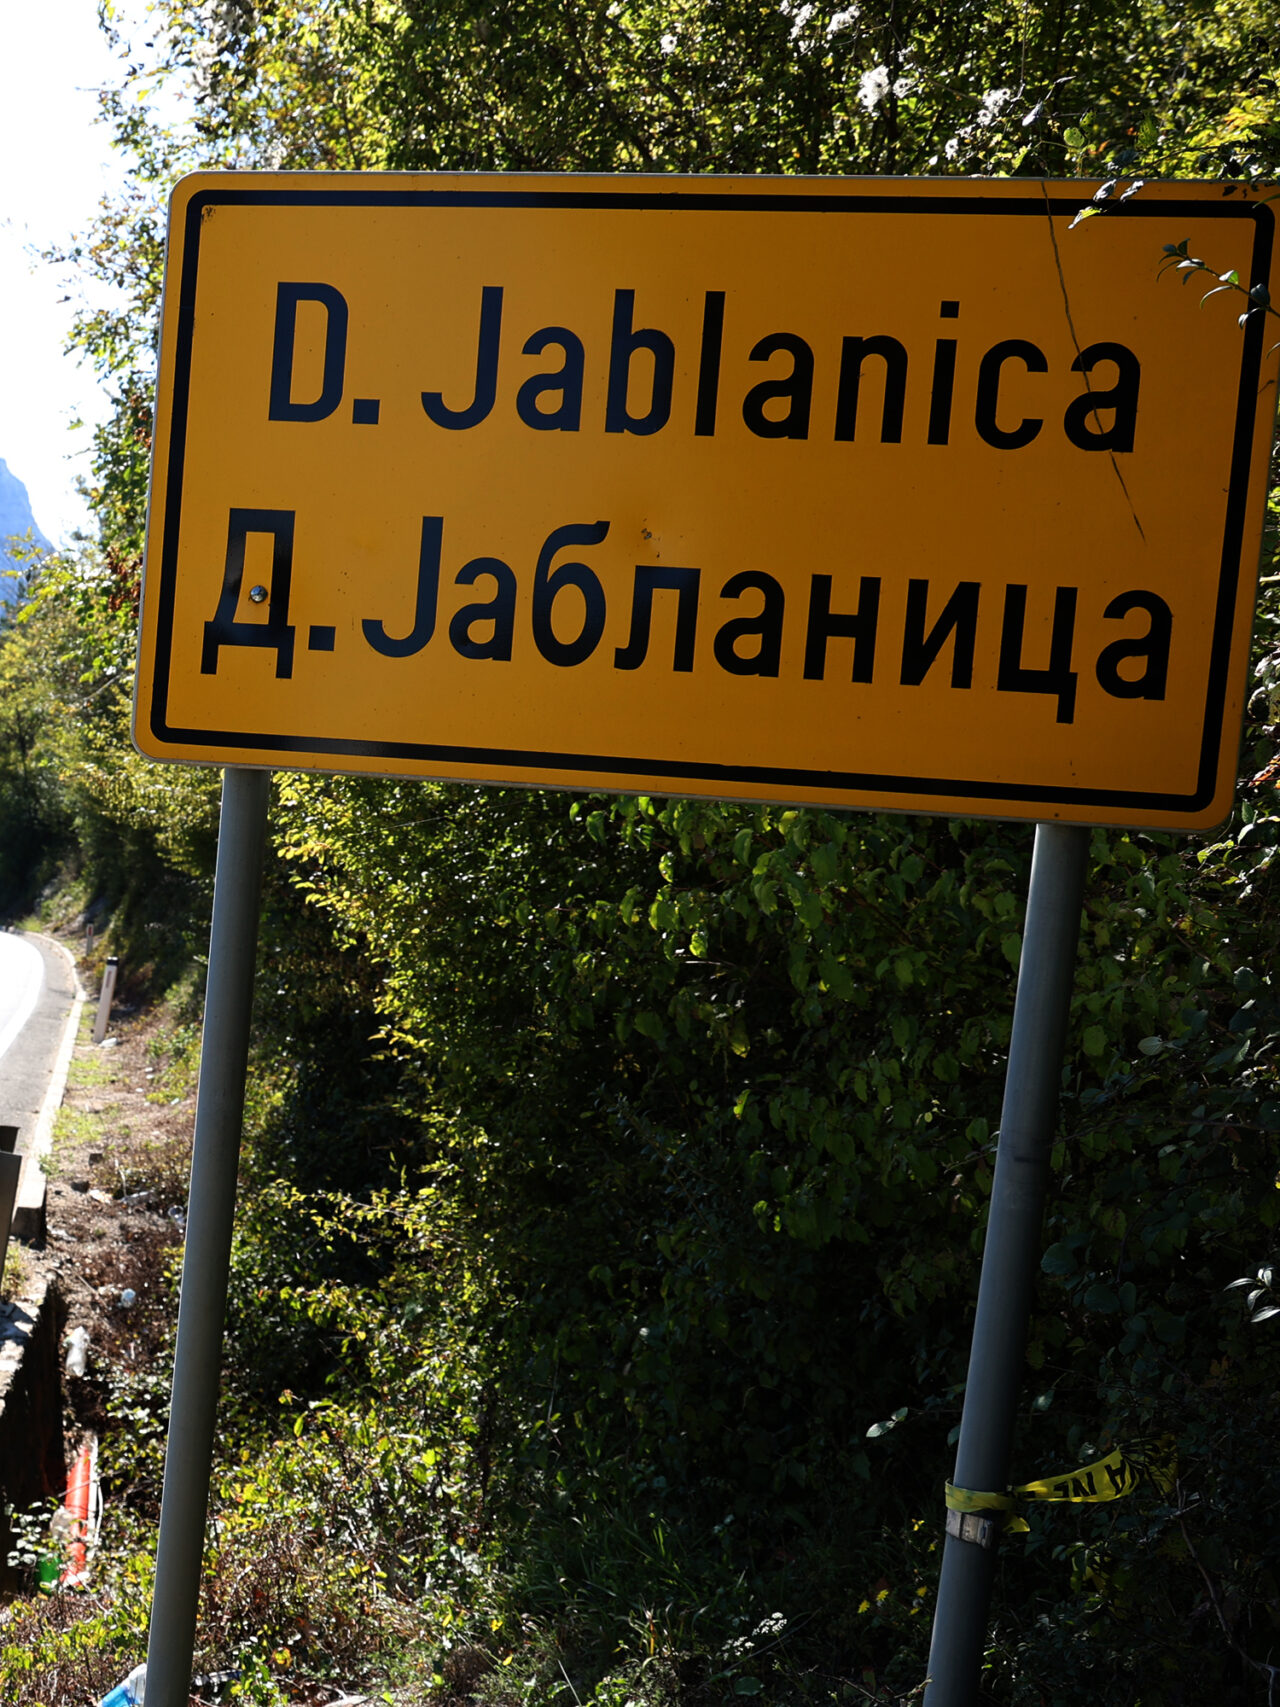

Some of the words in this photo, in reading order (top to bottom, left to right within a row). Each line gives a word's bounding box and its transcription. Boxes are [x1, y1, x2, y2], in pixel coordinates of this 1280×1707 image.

[268, 281, 380, 425] D.
[420, 286, 1141, 453] Jablanica
[200, 508, 336, 679] Д.
[361, 516, 1173, 724] Јабланица
